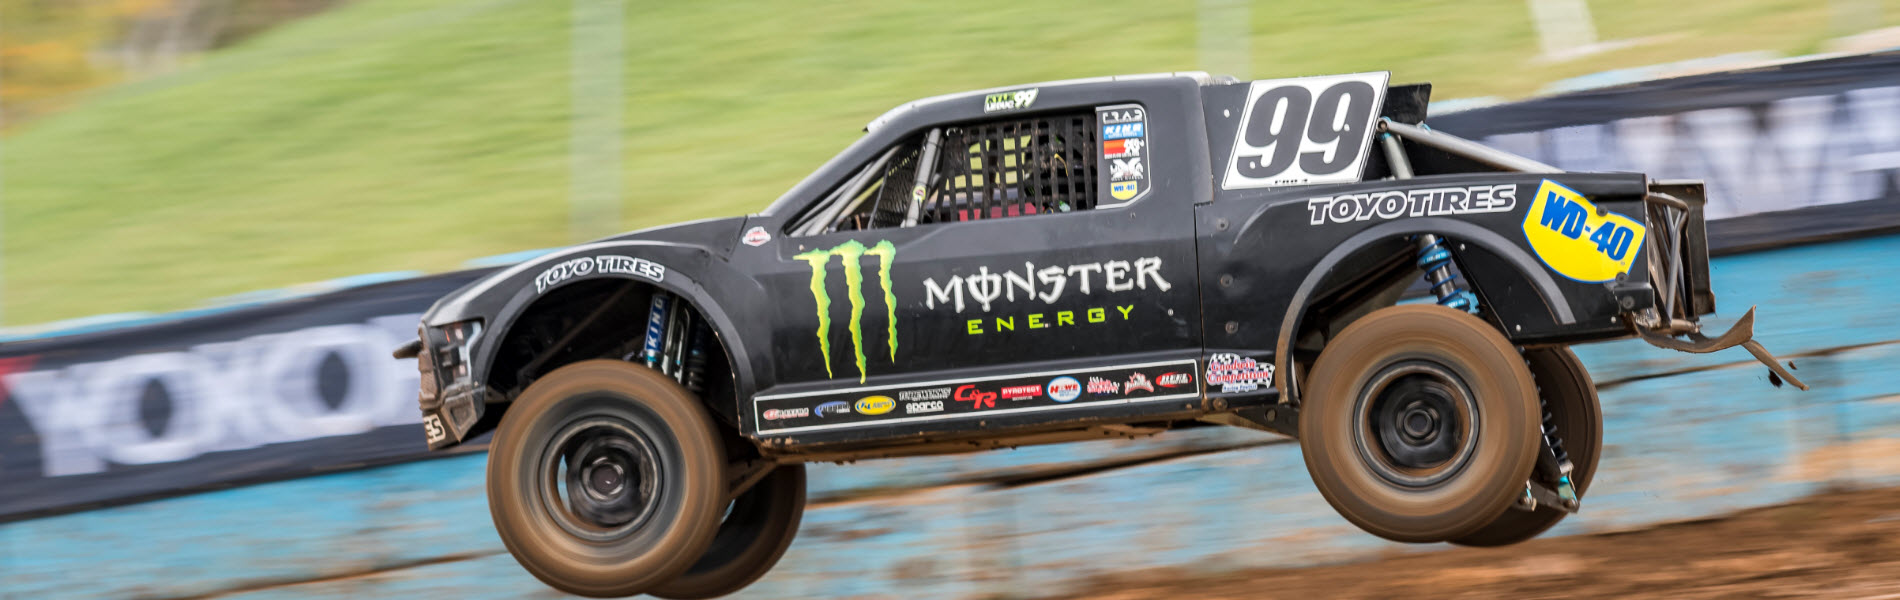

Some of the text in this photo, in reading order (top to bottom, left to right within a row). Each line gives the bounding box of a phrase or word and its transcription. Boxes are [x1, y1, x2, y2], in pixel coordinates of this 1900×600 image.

[1236, 80, 1376, 179] 99
[1308, 184, 1517, 225] TOYO TIRES
[1540, 190, 1635, 262] WD-40
[536, 255, 665, 294] TOYO TIRES
[923, 256, 1172, 313] MONSTER
[648, 297, 667, 348] KING
[967, 305, 1134, 335] ENERGY
[1208, 370, 1269, 384] Competition
